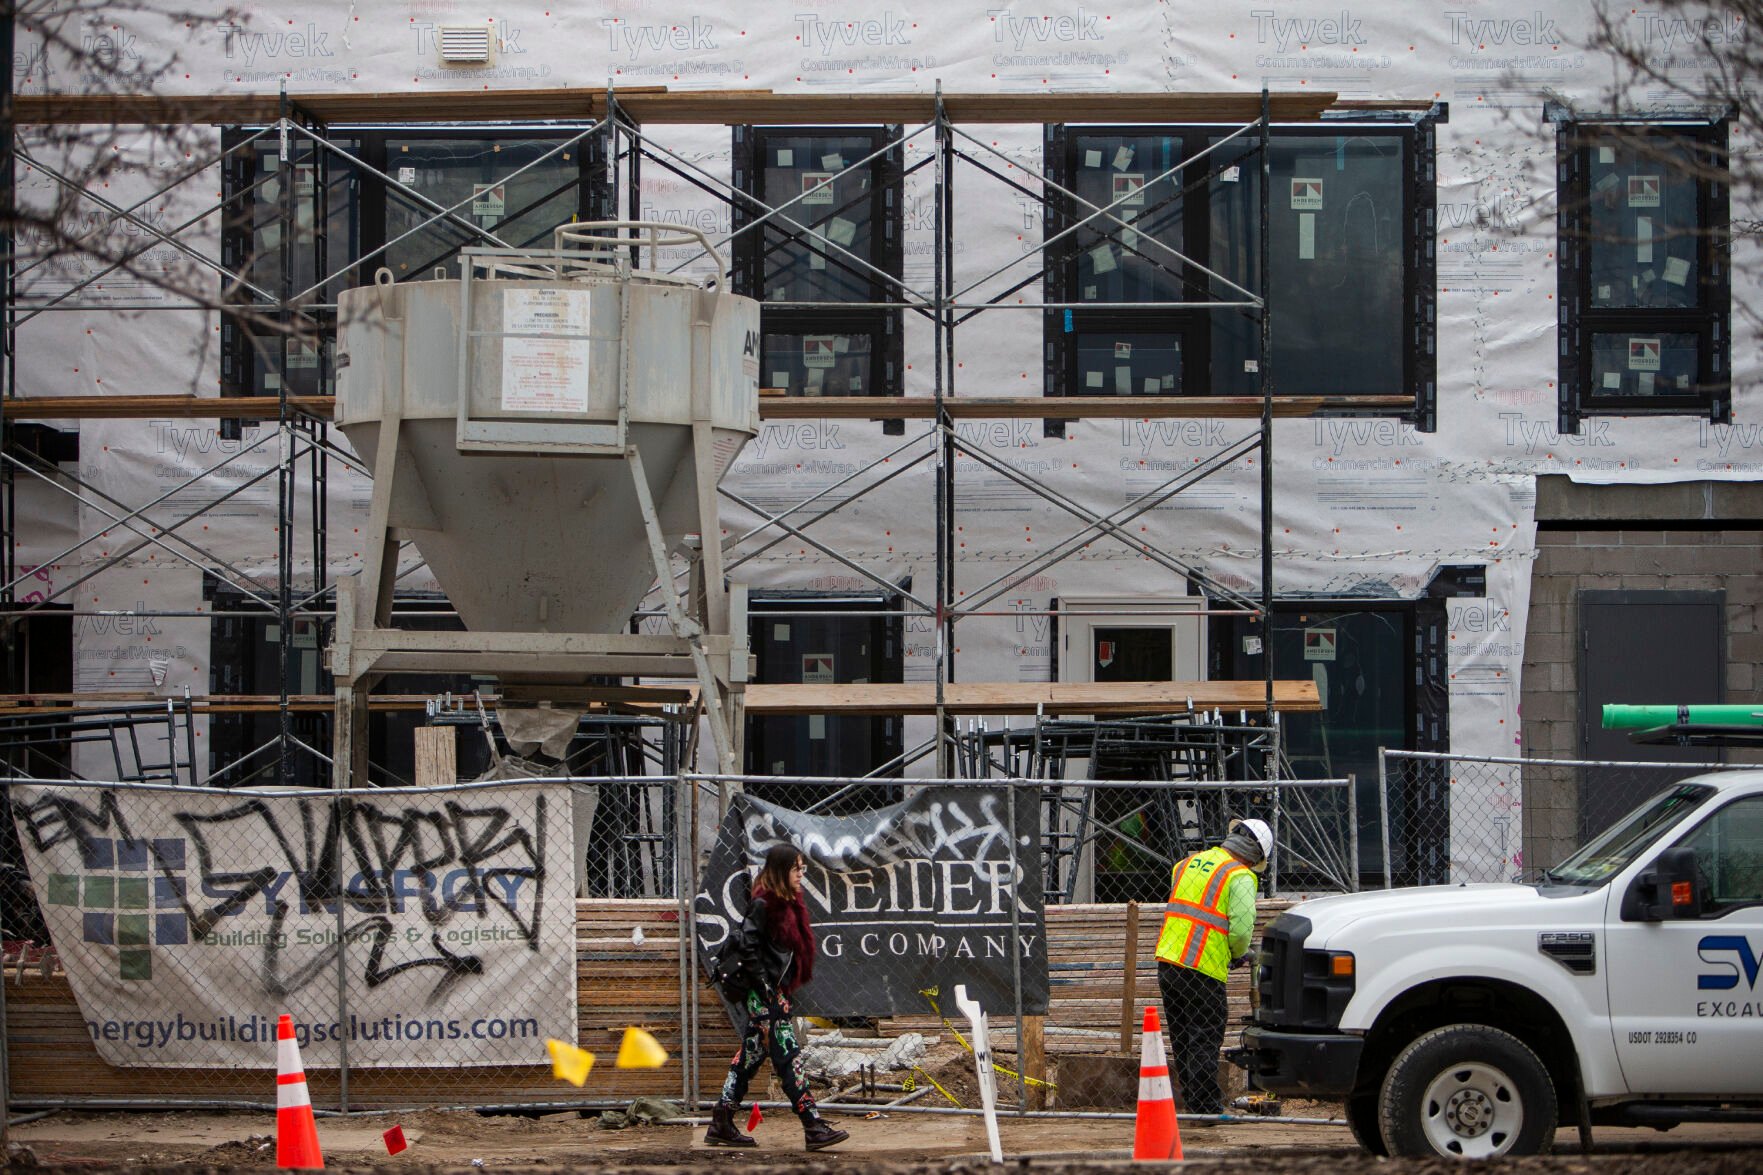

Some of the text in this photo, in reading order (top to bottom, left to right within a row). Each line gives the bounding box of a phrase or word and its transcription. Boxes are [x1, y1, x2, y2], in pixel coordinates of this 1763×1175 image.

[218, 23, 329, 67] Tyvek
[602, 16, 713, 61] Tyvek
[795, 10, 907, 55] Tyvek
[987, 7, 1099, 51] Tyvek
[1251, 9, 1362, 53] Tyvek
[1444, 10, 1556, 54] Tyvek
[204, 930, 288, 949] Building
[405, 927, 423, 943] &
[860, 932, 1037, 959] COMPANY
[1628, 1031, 1652, 1044] USDOT
